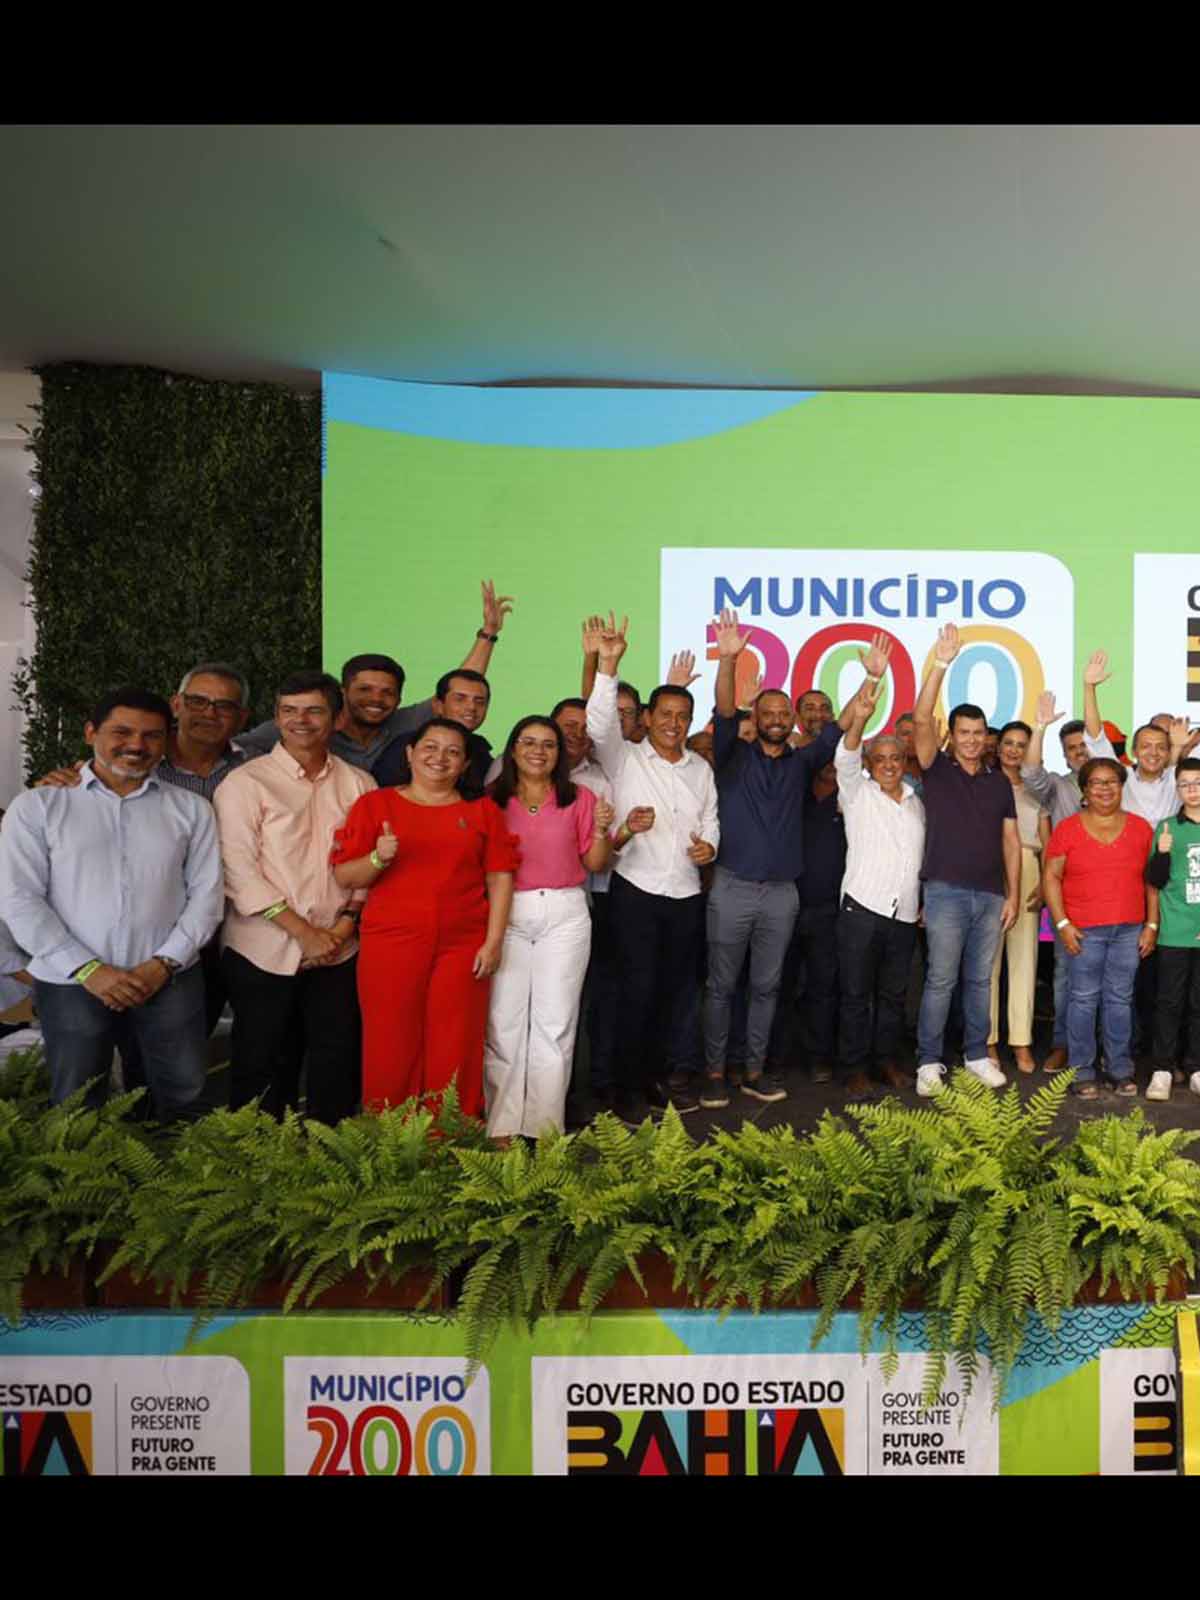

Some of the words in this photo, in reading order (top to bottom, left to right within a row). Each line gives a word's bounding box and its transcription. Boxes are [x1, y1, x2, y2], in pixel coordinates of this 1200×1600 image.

[713, 574, 1026, 619] MUNICÍPIO
[310, 1371, 466, 1401] MUNICÍPIO
[566, 1383, 694, 1406] GOVERNO
[703, 1383, 739, 1404] DO
[748, 1382, 844, 1403] ESTADO
[882, 1392, 959, 1407] GOVNO
[130, 1396, 210, 1412] GOVERNO
[131, 1415, 201, 1430] PRESENTE
[882, 1410, 951, 1424] PRESENTE
[131, 1438, 194, 1452] FUTURO
[306, 1405, 477, 1475] 200
[567, 1408, 844, 1475] BAHIA
[882, 1433, 944, 1447] FUTURO
[131, 1456, 162, 1471] PRA
[166, 1456, 216, 1471] GENTE
[882, 1452, 912, 1465] PRA
[915, 1450, 965, 1465] GENTE
